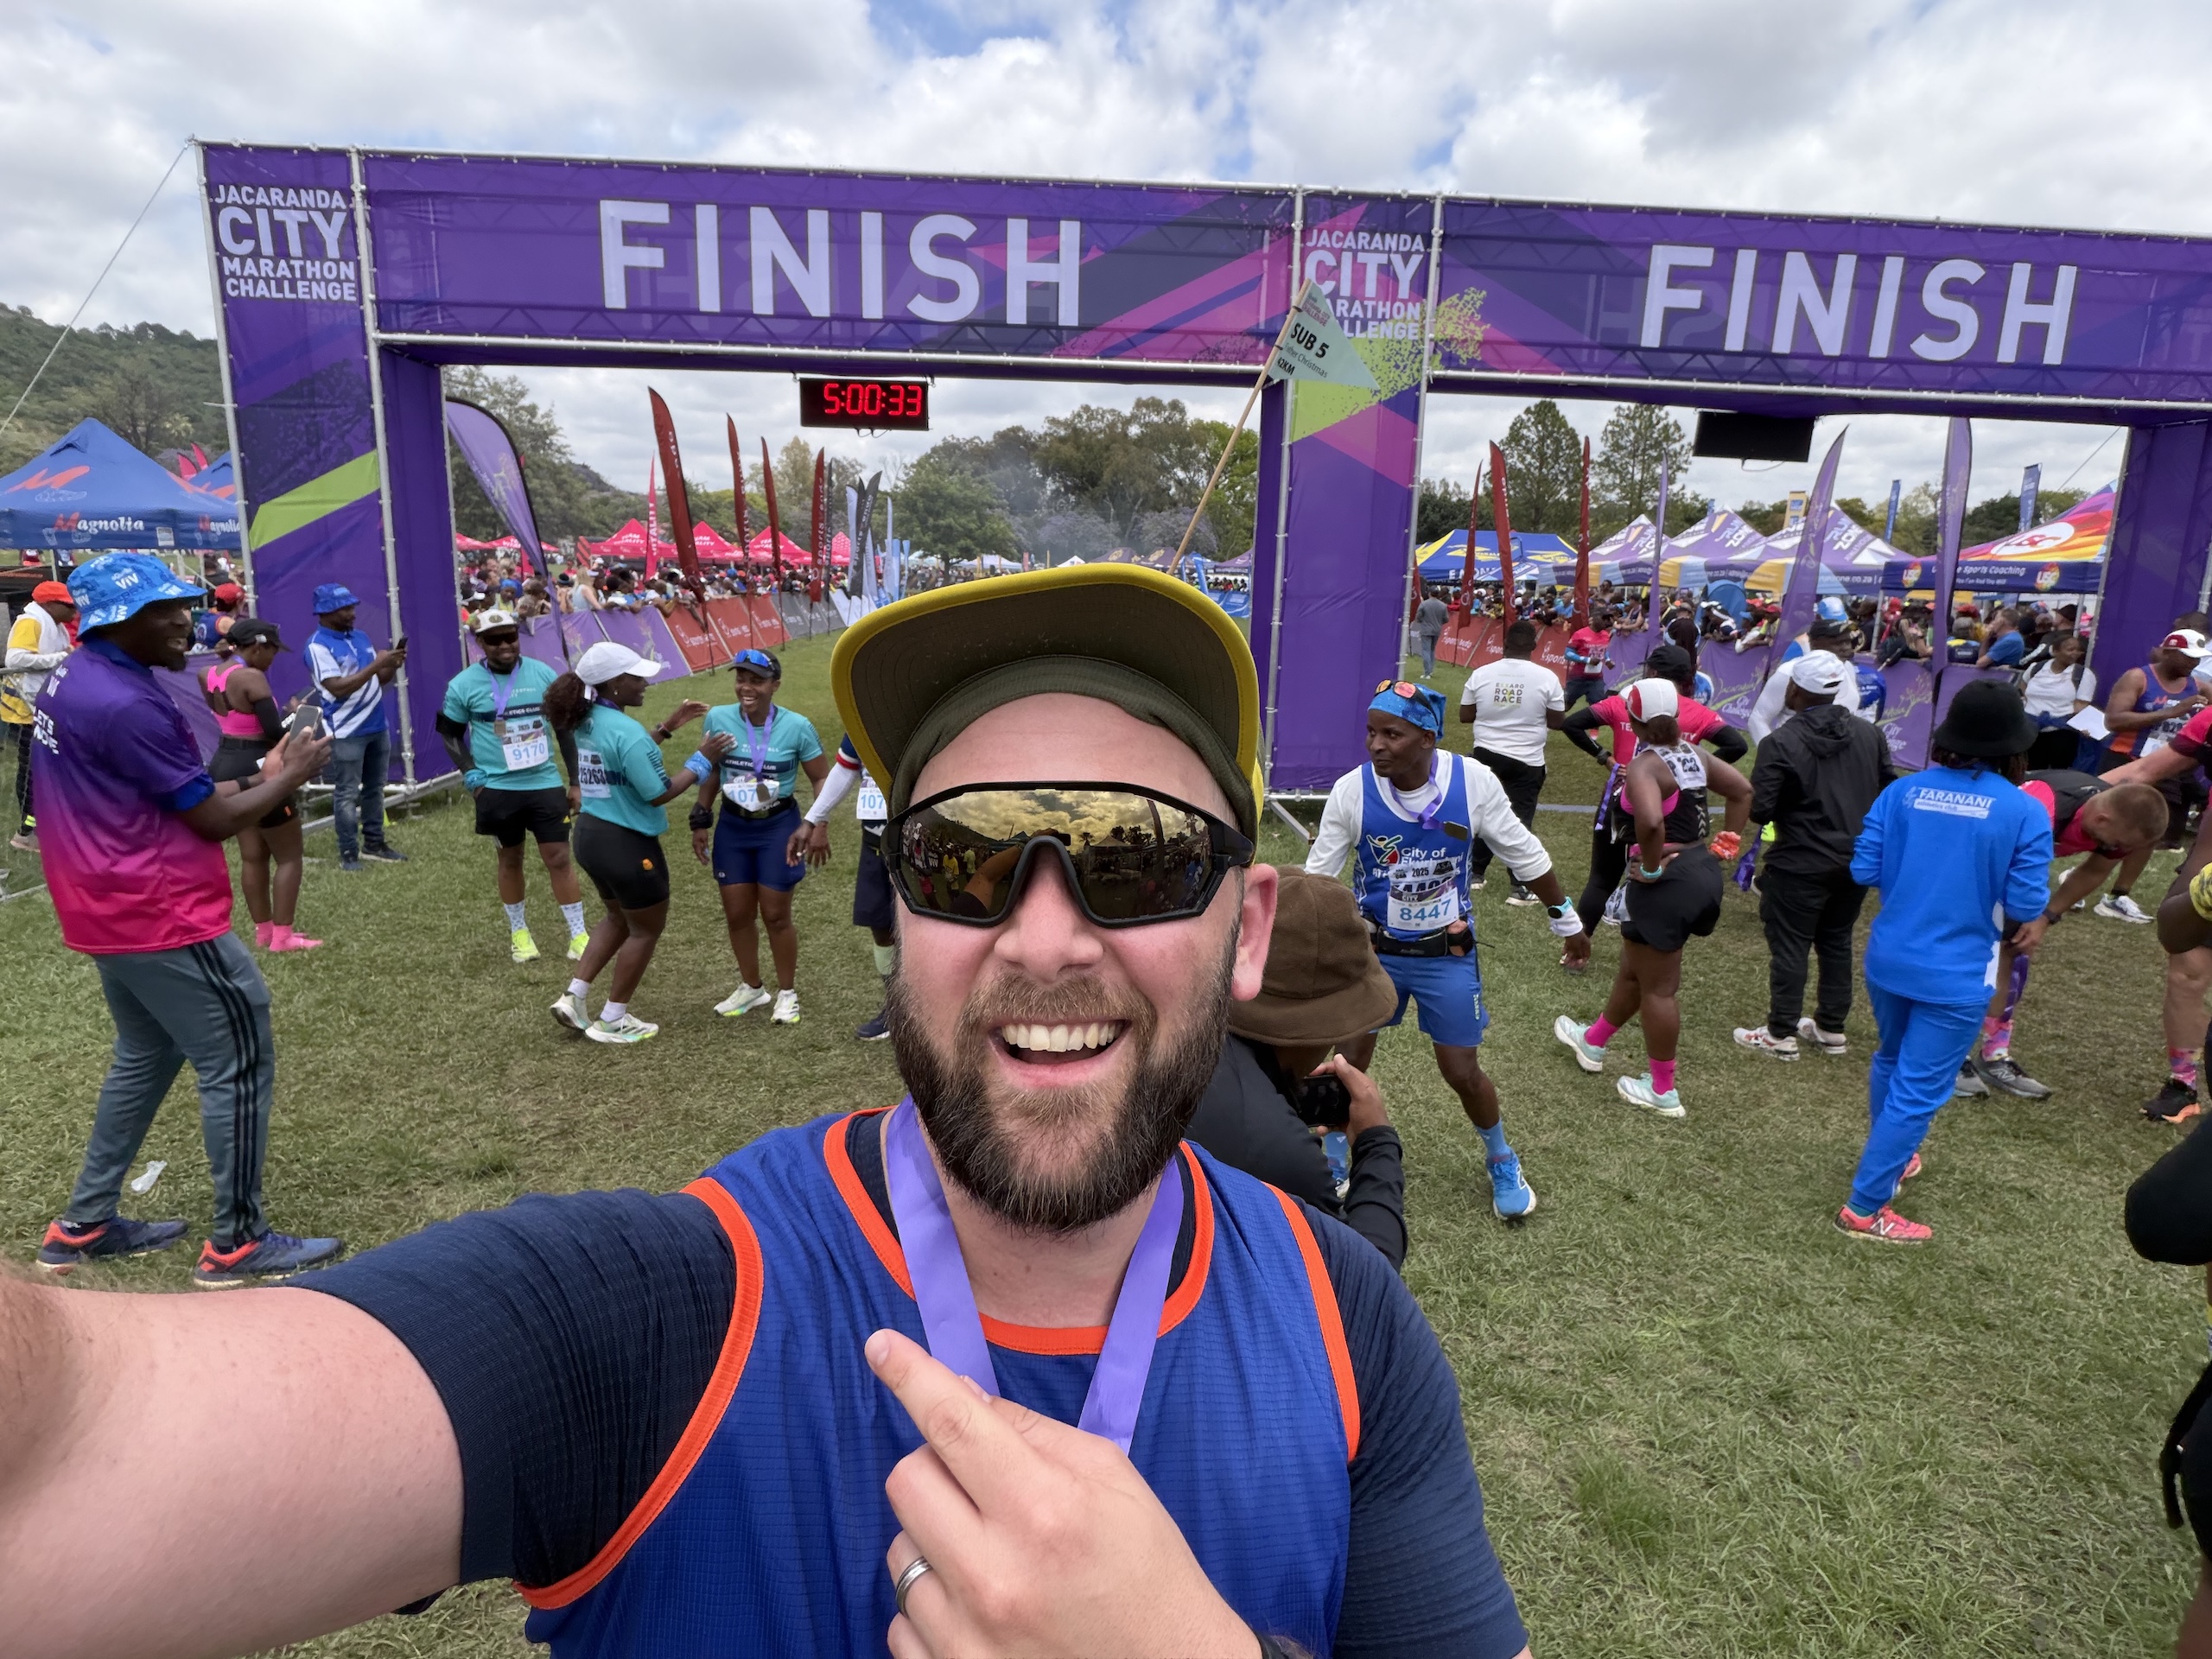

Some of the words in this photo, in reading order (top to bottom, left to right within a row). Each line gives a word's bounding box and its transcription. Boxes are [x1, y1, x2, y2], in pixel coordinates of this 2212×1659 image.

[215, 185, 346, 209] JACARANDA
[219, 207, 346, 258] CITY
[1306, 229, 1426, 252] JACARANDA
[222, 257, 355, 280] MARATHON
[600, 200, 1081, 327] FINISH
[1305, 250, 1424, 300] CITY
[226, 278, 357, 301] CHALLENGE
[1642, 245, 2077, 365] FINISH
[1291, 322, 1317, 351] SUB
[1315, 342, 1330, 359] 5
[1277, 357, 1295, 376] 42KM
[1297, 353, 1328, 378] Christmas
[824, 383, 922, 416] 5:00:33
[53, 512, 145, 534] Magnolia
[1963, 565, 1987, 575] Sports
[1989, 565, 2026, 576] Coaching
[1494, 695, 1522, 704] RACE
[1495, 688, 1522, 696] ROAD
[1882, 722, 1904, 739] City
[512, 743, 545, 760] 9170
[725, 759, 753, 767] ATHLETIC
[1919, 788, 1993, 809] FARANANI
[1401, 847, 1427, 860] City
[1431, 847, 1447, 858] of
[1412, 867, 1429, 878] 2025
[1400, 899, 1452, 921] 8447
